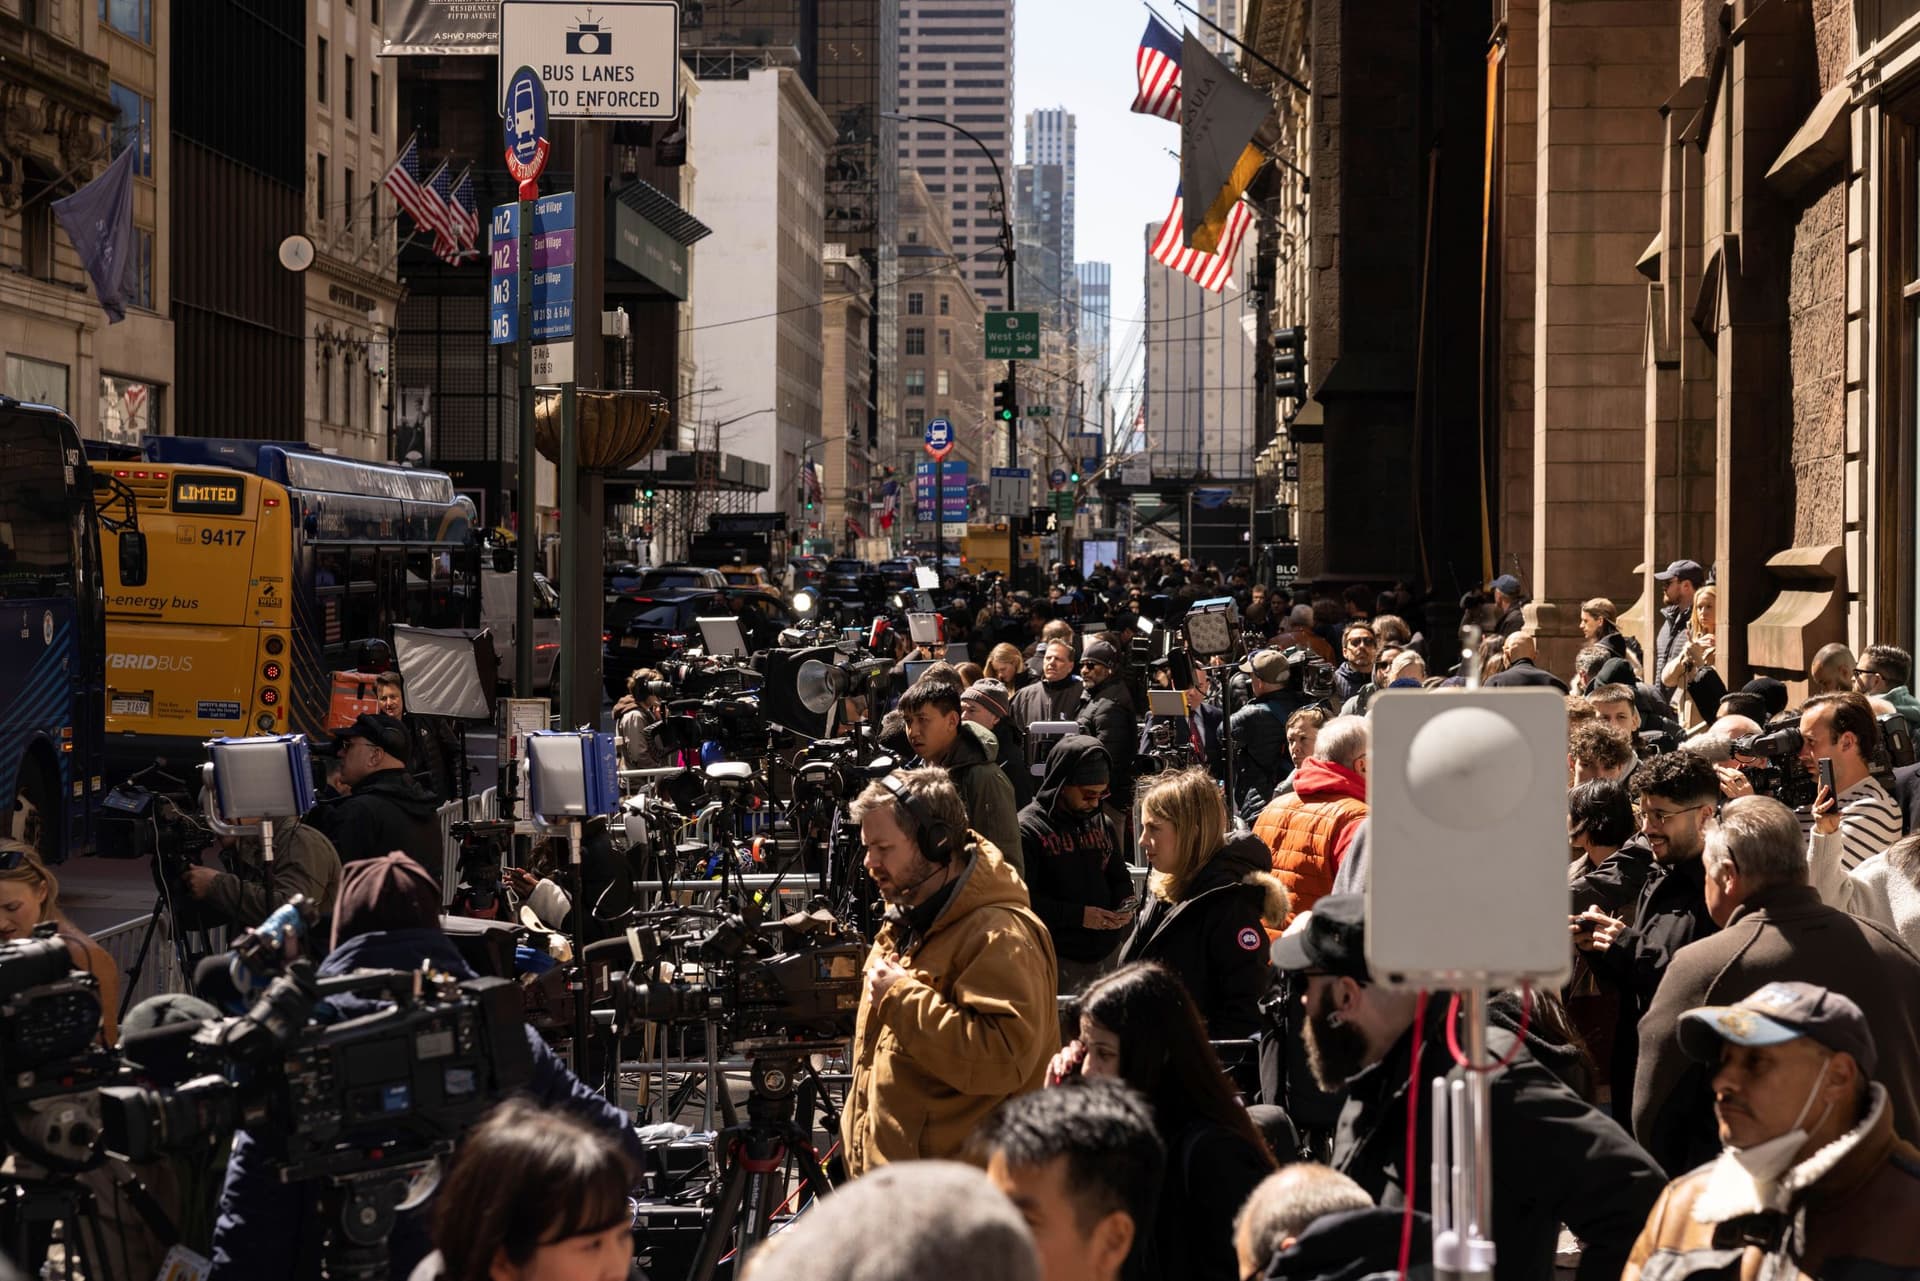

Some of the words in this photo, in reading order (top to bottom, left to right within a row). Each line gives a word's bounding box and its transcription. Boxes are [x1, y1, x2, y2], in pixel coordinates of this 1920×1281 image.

[447, 12, 469, 20] FIFTH
[470, 12, 496, 20] AVENUE
[434, 32, 441, 40] A
[442, 32, 465, 40] SHVO
[466, 32, 499, 40] PROPER
[542, 65, 574, 82] BUS
[582, 66, 635, 82] LANES
[576, 91, 660, 108] ENFORCED
[1182, 77, 1217, 144] NSULA
[517, 147, 545, 179] STANDING
[535, 204, 546, 215] East
[545, 201, 563, 214] Village
[494, 209, 511, 235] M2
[534, 240, 545, 250] East
[545, 237, 562, 249] Village
[494, 244, 511, 270] M2
[534, 274, 545, 286] East
[545, 273, 561, 284] Village
[493, 278, 510, 305] M3
[493, 313, 509, 339] M5
[987, 332, 1012, 341] West
[1016, 331, 1037, 341] Side
[991, 345, 1011, 355] Hwy
[179, 486, 237, 503] LIMITED
[201, 529, 246, 547] 9417
[171, 595, 199, 610] bus
